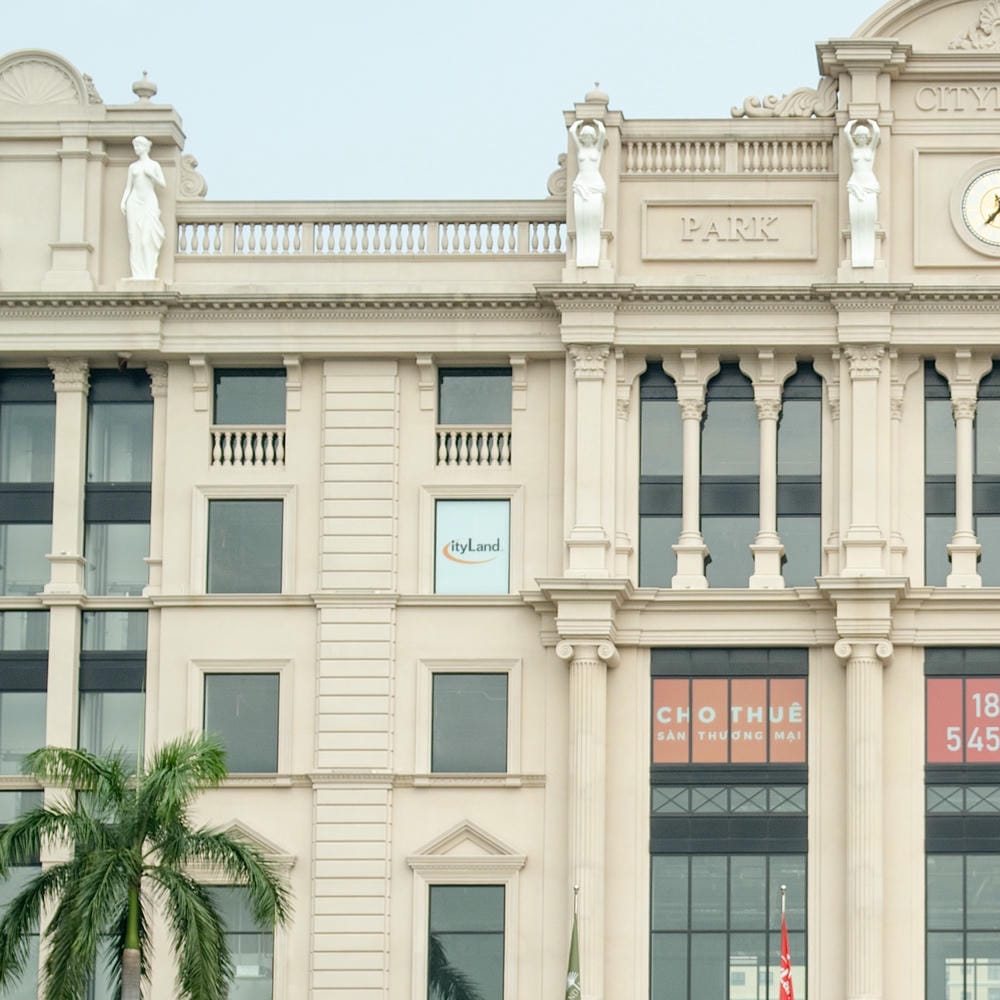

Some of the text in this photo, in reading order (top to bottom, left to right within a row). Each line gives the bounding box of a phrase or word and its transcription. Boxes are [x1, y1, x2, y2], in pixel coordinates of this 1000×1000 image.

[681, 216, 779, 242] PARK
[656, 702, 803, 724] CHO THUÊ
